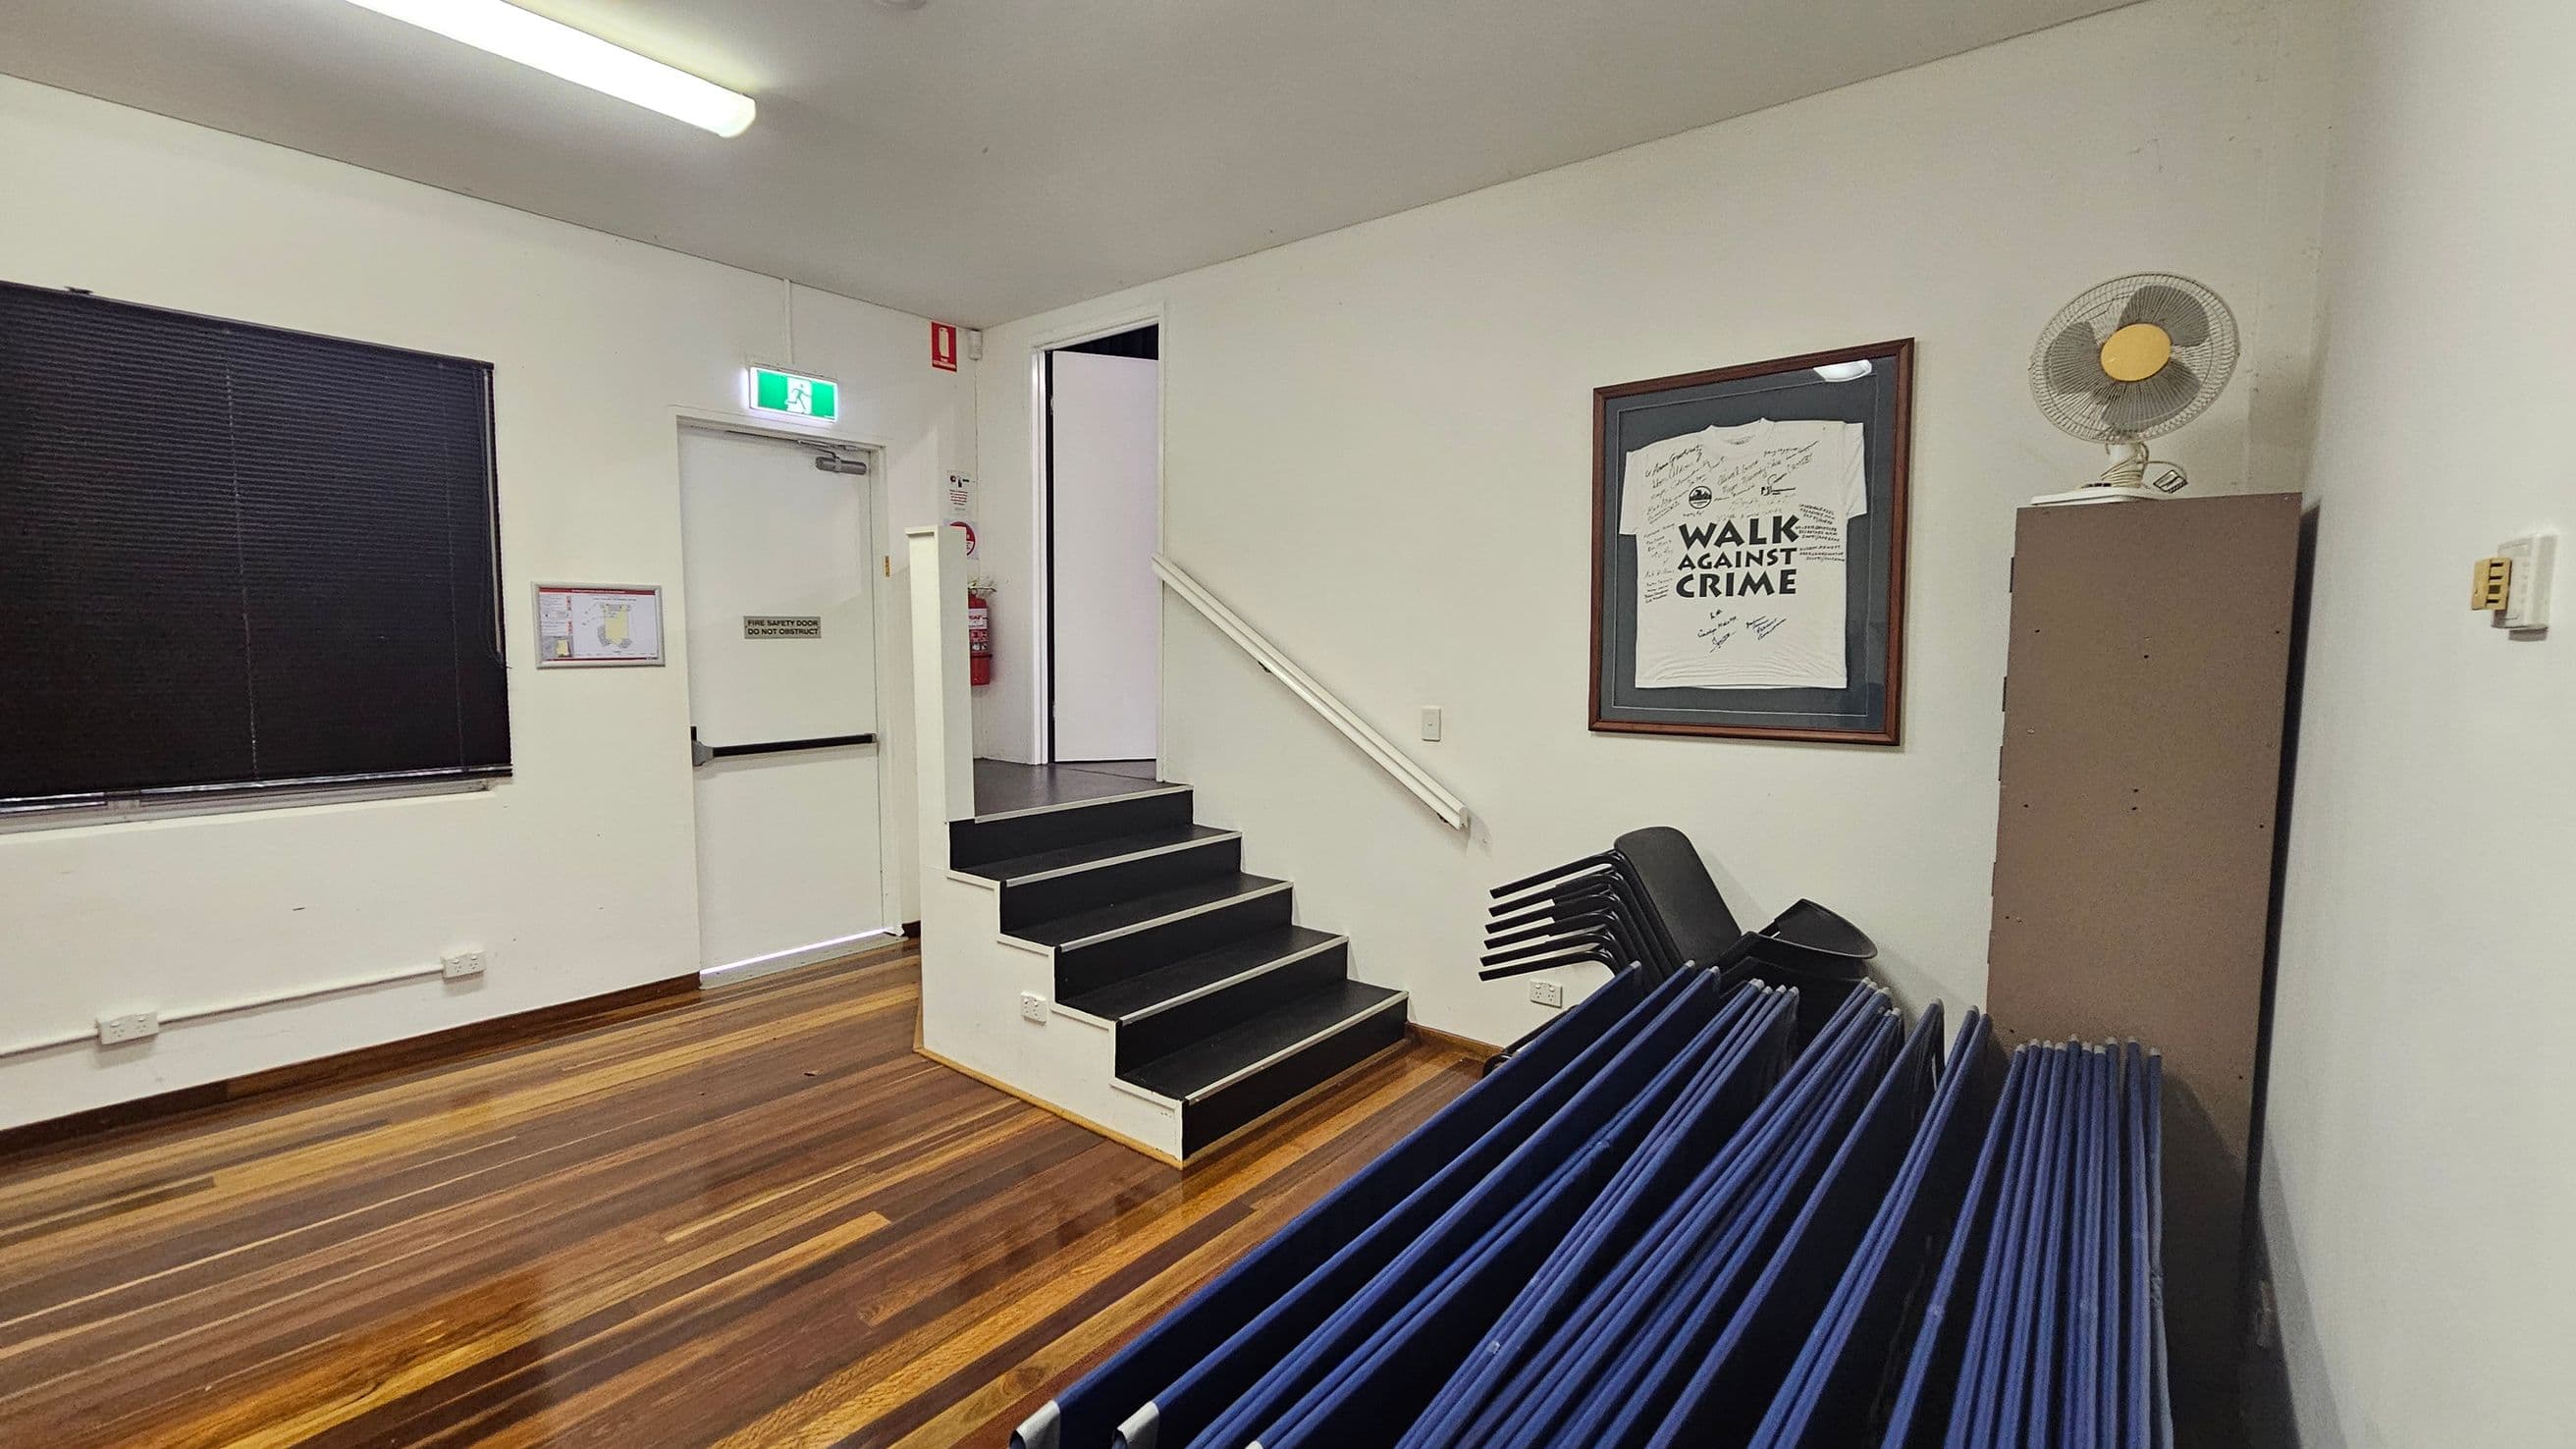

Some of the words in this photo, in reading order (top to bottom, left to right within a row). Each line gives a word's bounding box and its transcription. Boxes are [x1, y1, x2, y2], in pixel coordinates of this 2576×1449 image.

[1678, 514, 1799, 551] WALK
[1677, 548, 1798, 570] AGAINST
[1676, 569, 1797, 598] CRIME
